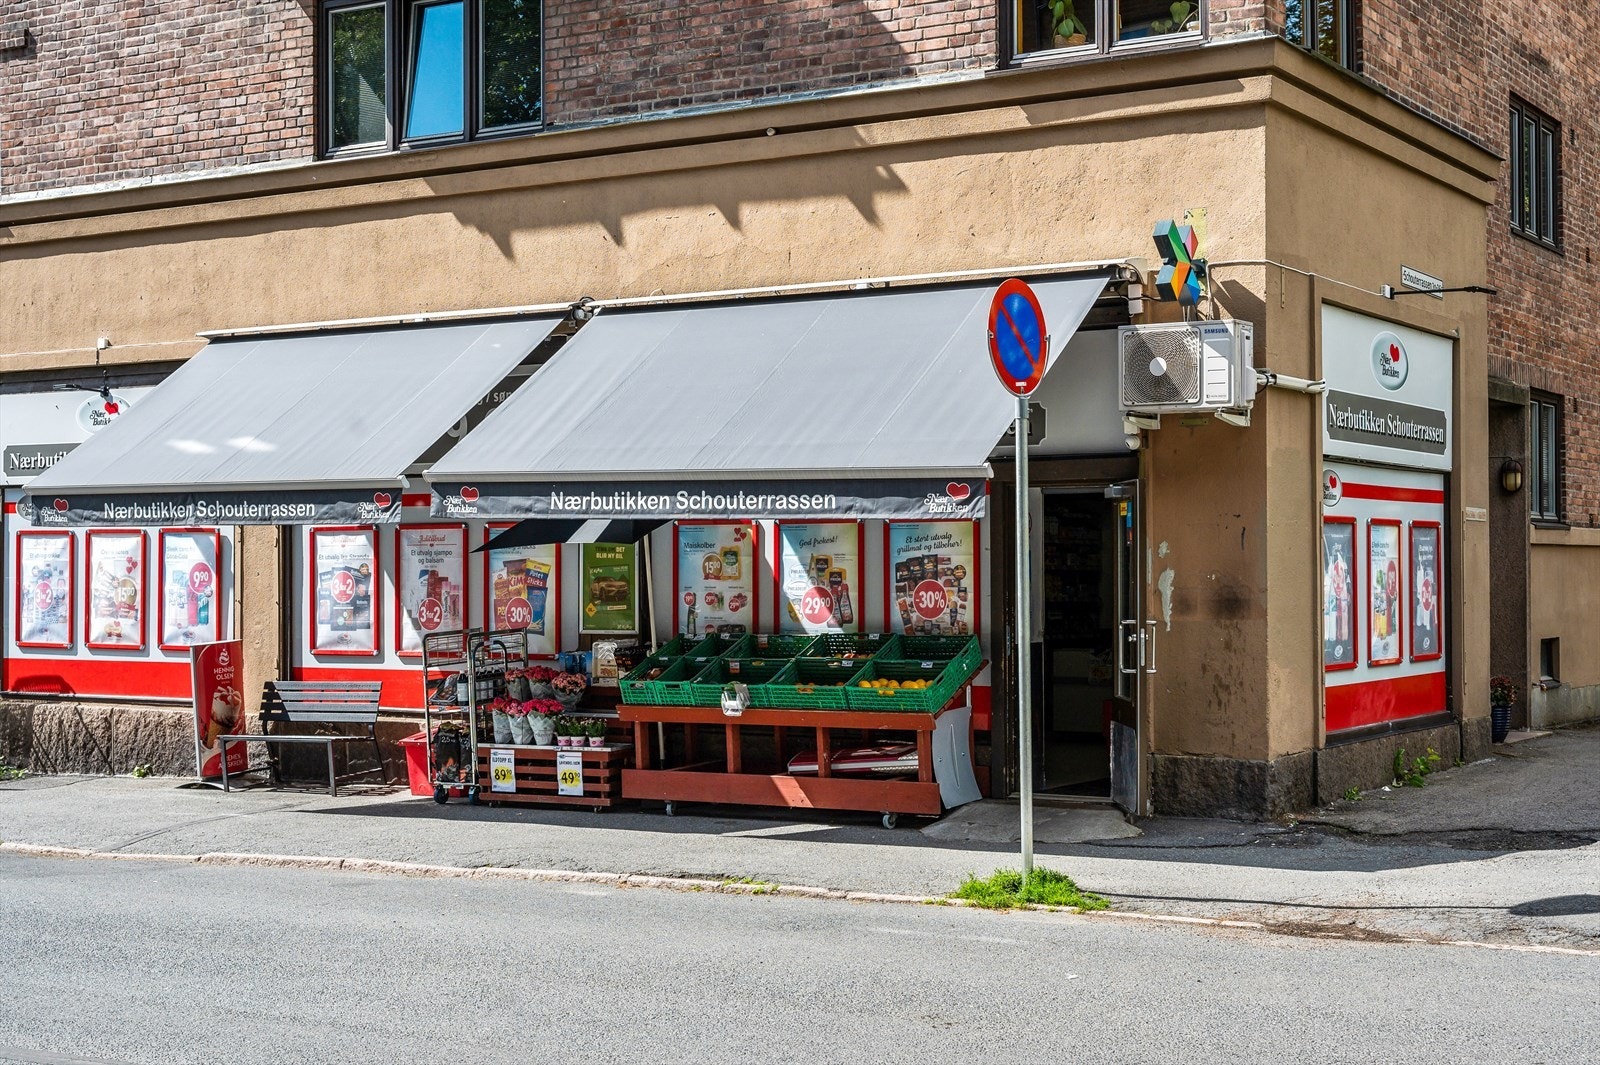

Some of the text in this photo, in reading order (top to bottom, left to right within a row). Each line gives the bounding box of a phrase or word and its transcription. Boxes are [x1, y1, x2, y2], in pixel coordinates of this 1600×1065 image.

[1382, 364, 1400, 379] Butikken
[1328, 403, 1445, 443] Nærbutikken Schouterrassen
[443, 495, 464, 507] Nær
[550, 490, 837, 511] Nærbutikken Schouterrassen
[924, 493, 950, 506] Nær
[104, 500, 316, 519] Nærbutikken Schouterrassen
[447, 503, 478, 515] Butikken
[929, 501, 970, 514] Butikken
[905, 531, 953, 544] Et stort utvalg
[683, 541, 716, 549] Maiskolber
[896, 542, 922, 556] grillmat
[923, 544, 932, 553] og
[417, 549, 433, 557] utvalg
[433, 549, 453, 557] sjampo
[425, 556, 445, 564] balsam
[333, 579, 340, 595] 3
[346, 578, 353, 594] 2
[527, 576, 543, 587] Sticks
[35, 589, 41, 603] 3
[46, 589, 52, 603] 2
[915, 590, 945, 609] -30%
[804, 597, 831, 615] 2990
[420, 606, 426, 623] 3
[433, 606, 441, 623] 2
[508, 606, 531, 623] -30%
[213, 666, 235, 675] HENNIG
[215, 673, 234, 681] OLSEN
[494, 768, 512, 781] 8990
[561, 772, 580, 784] 4990
